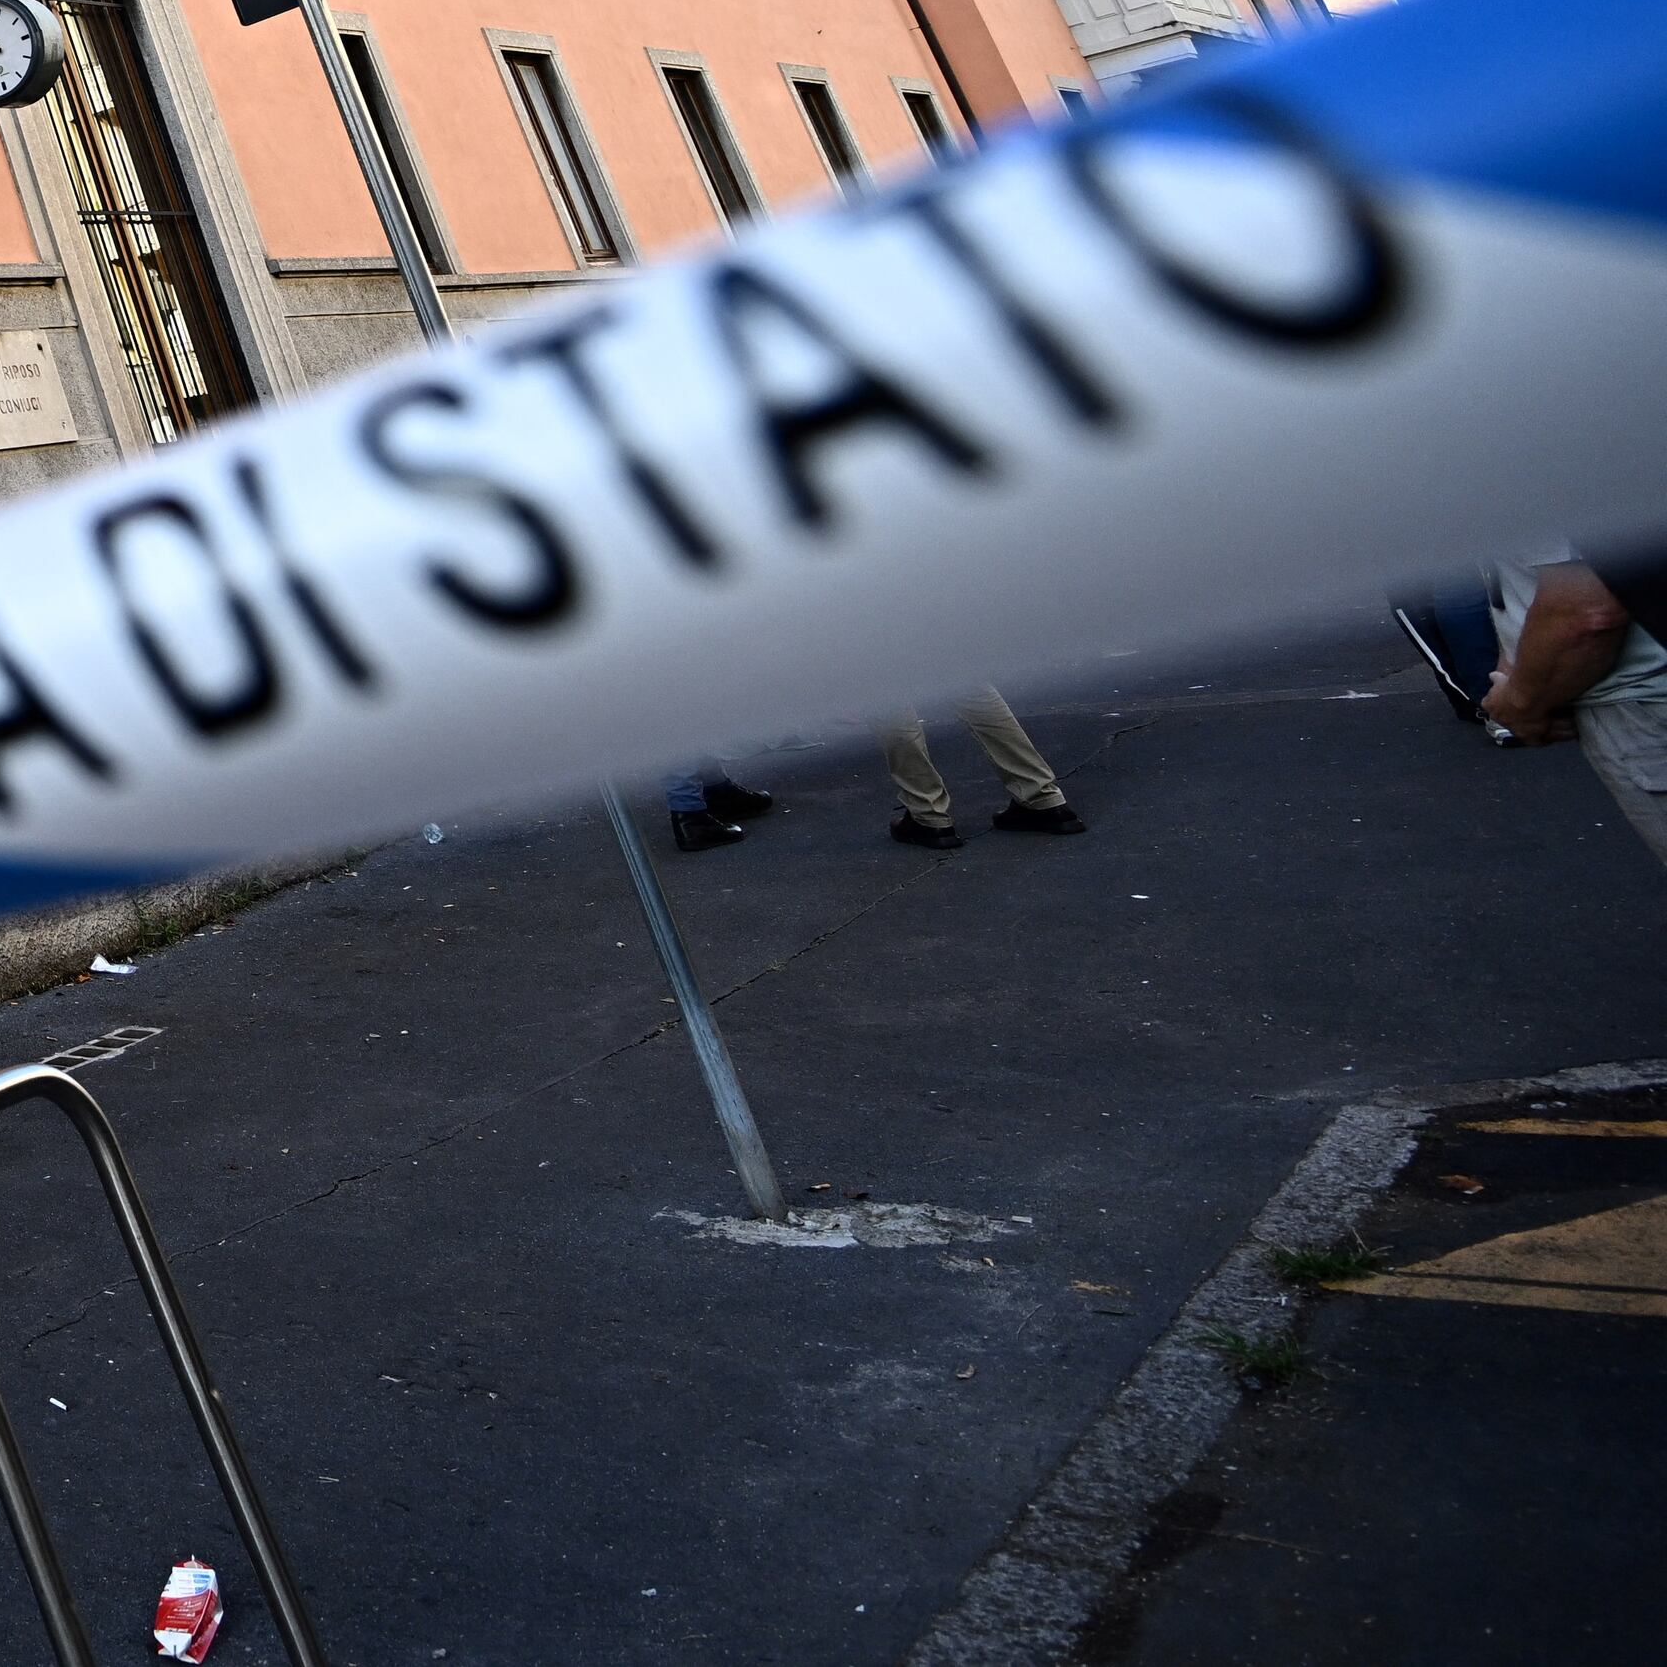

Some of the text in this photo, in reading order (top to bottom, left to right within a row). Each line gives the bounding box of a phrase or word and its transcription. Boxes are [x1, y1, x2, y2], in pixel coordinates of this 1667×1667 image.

[2, 363, 41, 381] RIPOSO
[89, 454, 381, 736] DI
[355, 86, 1407, 632] STATO
